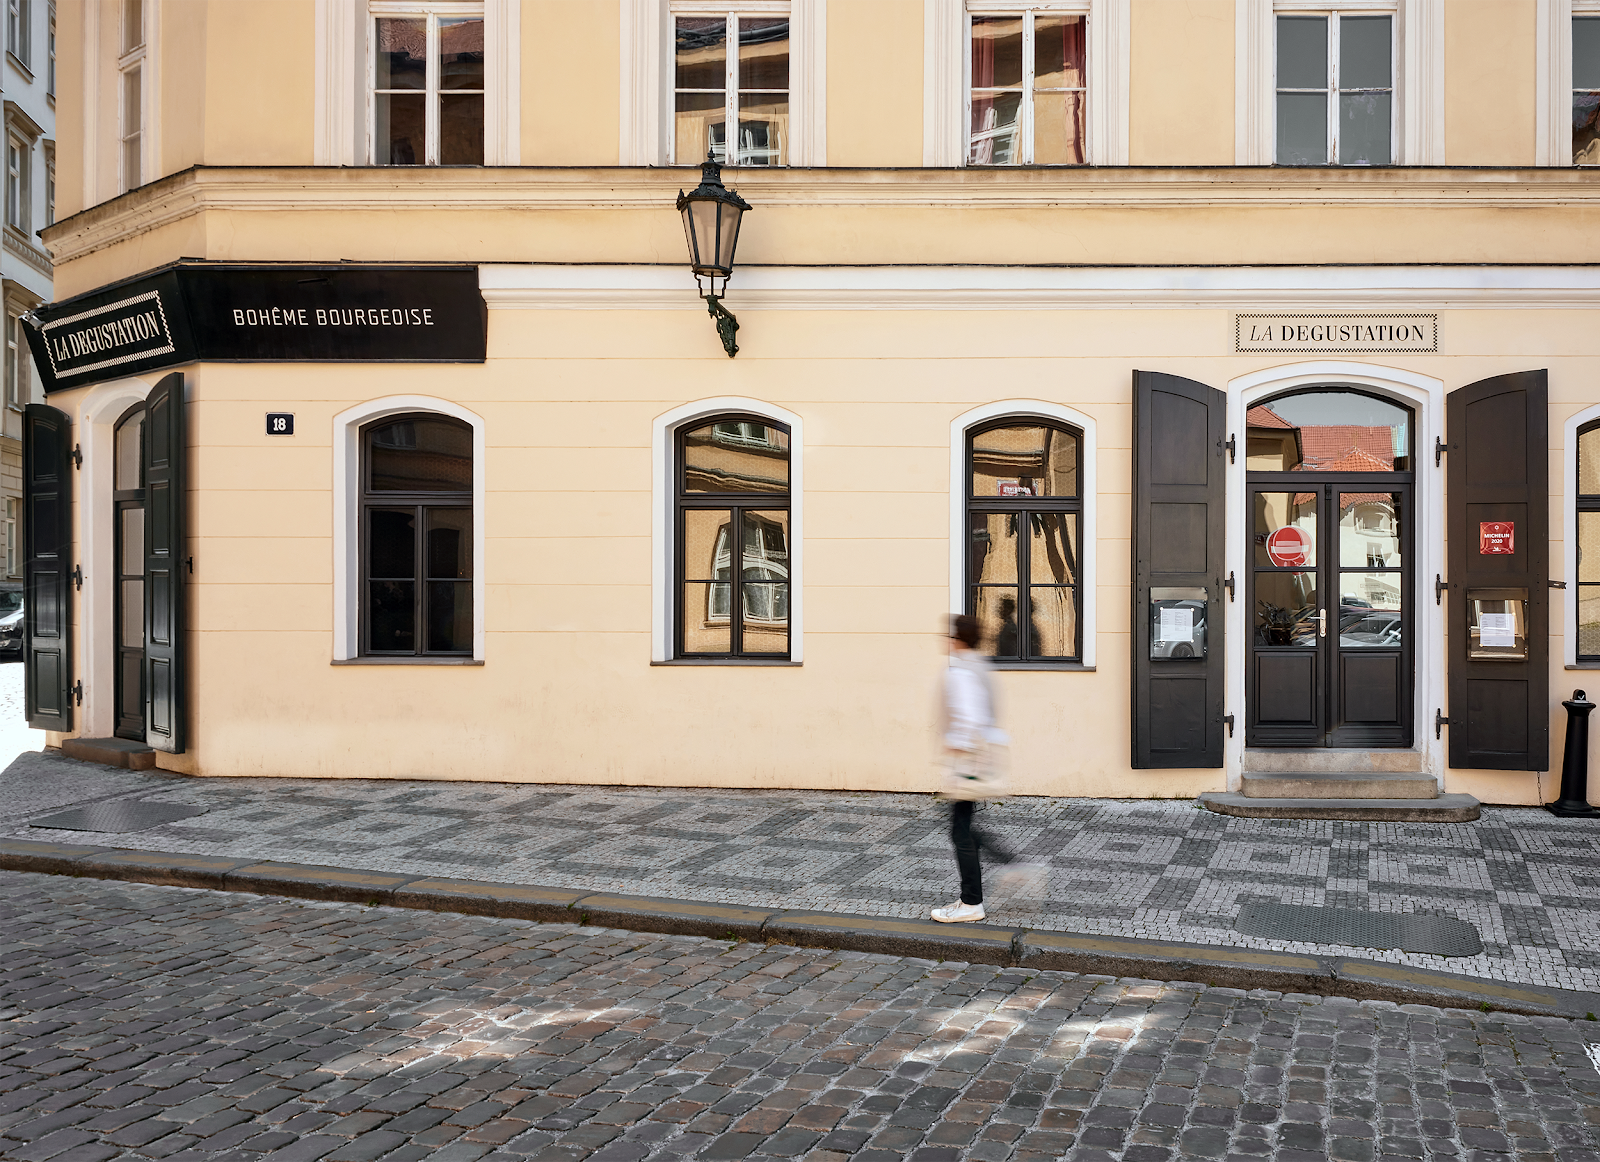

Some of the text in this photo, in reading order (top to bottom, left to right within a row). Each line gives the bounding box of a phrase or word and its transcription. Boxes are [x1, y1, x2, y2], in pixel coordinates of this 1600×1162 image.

[233, 306, 434, 326] BOHÊME BOURGEOISE
[53, 310, 160, 362] LA DEGUSTATION
[1250, 325, 1425, 342] LA DEGUSTATION
[273, 417, 287, 431] 18
